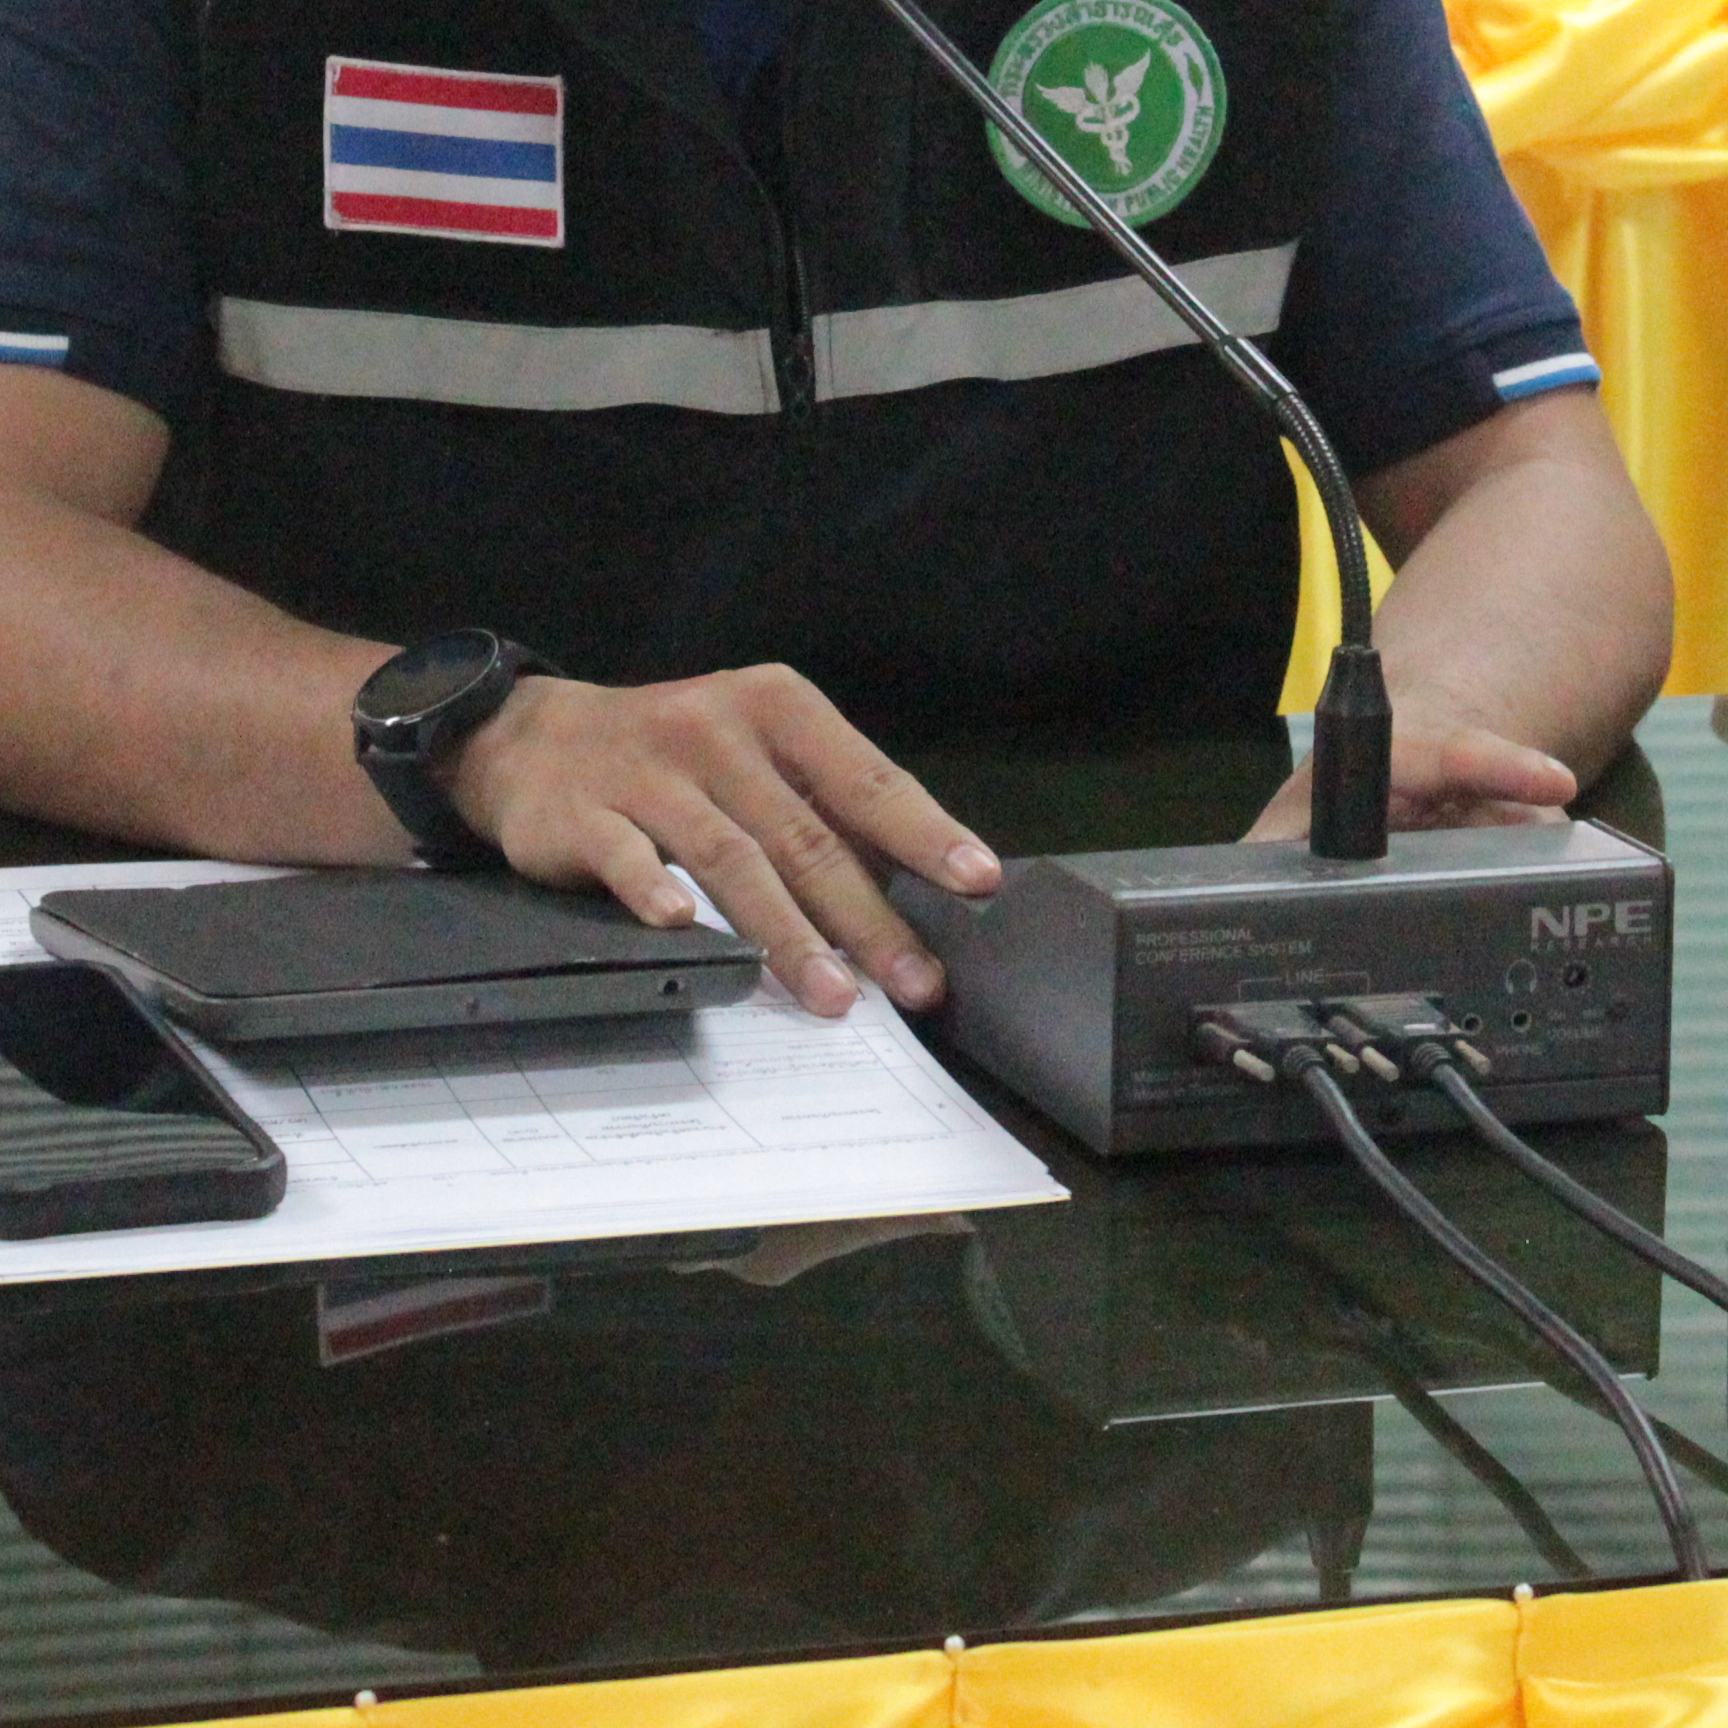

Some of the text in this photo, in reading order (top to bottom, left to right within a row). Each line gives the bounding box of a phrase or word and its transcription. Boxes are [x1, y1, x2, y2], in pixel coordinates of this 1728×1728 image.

[1530, 899, 1654, 938] NPE
[1135, 928, 1255, 947] PROFESSIONAL
[1134, 939, 1313, 965] CONFERENCE SYSTEM
[1284, 968, 1326, 985] LINE
